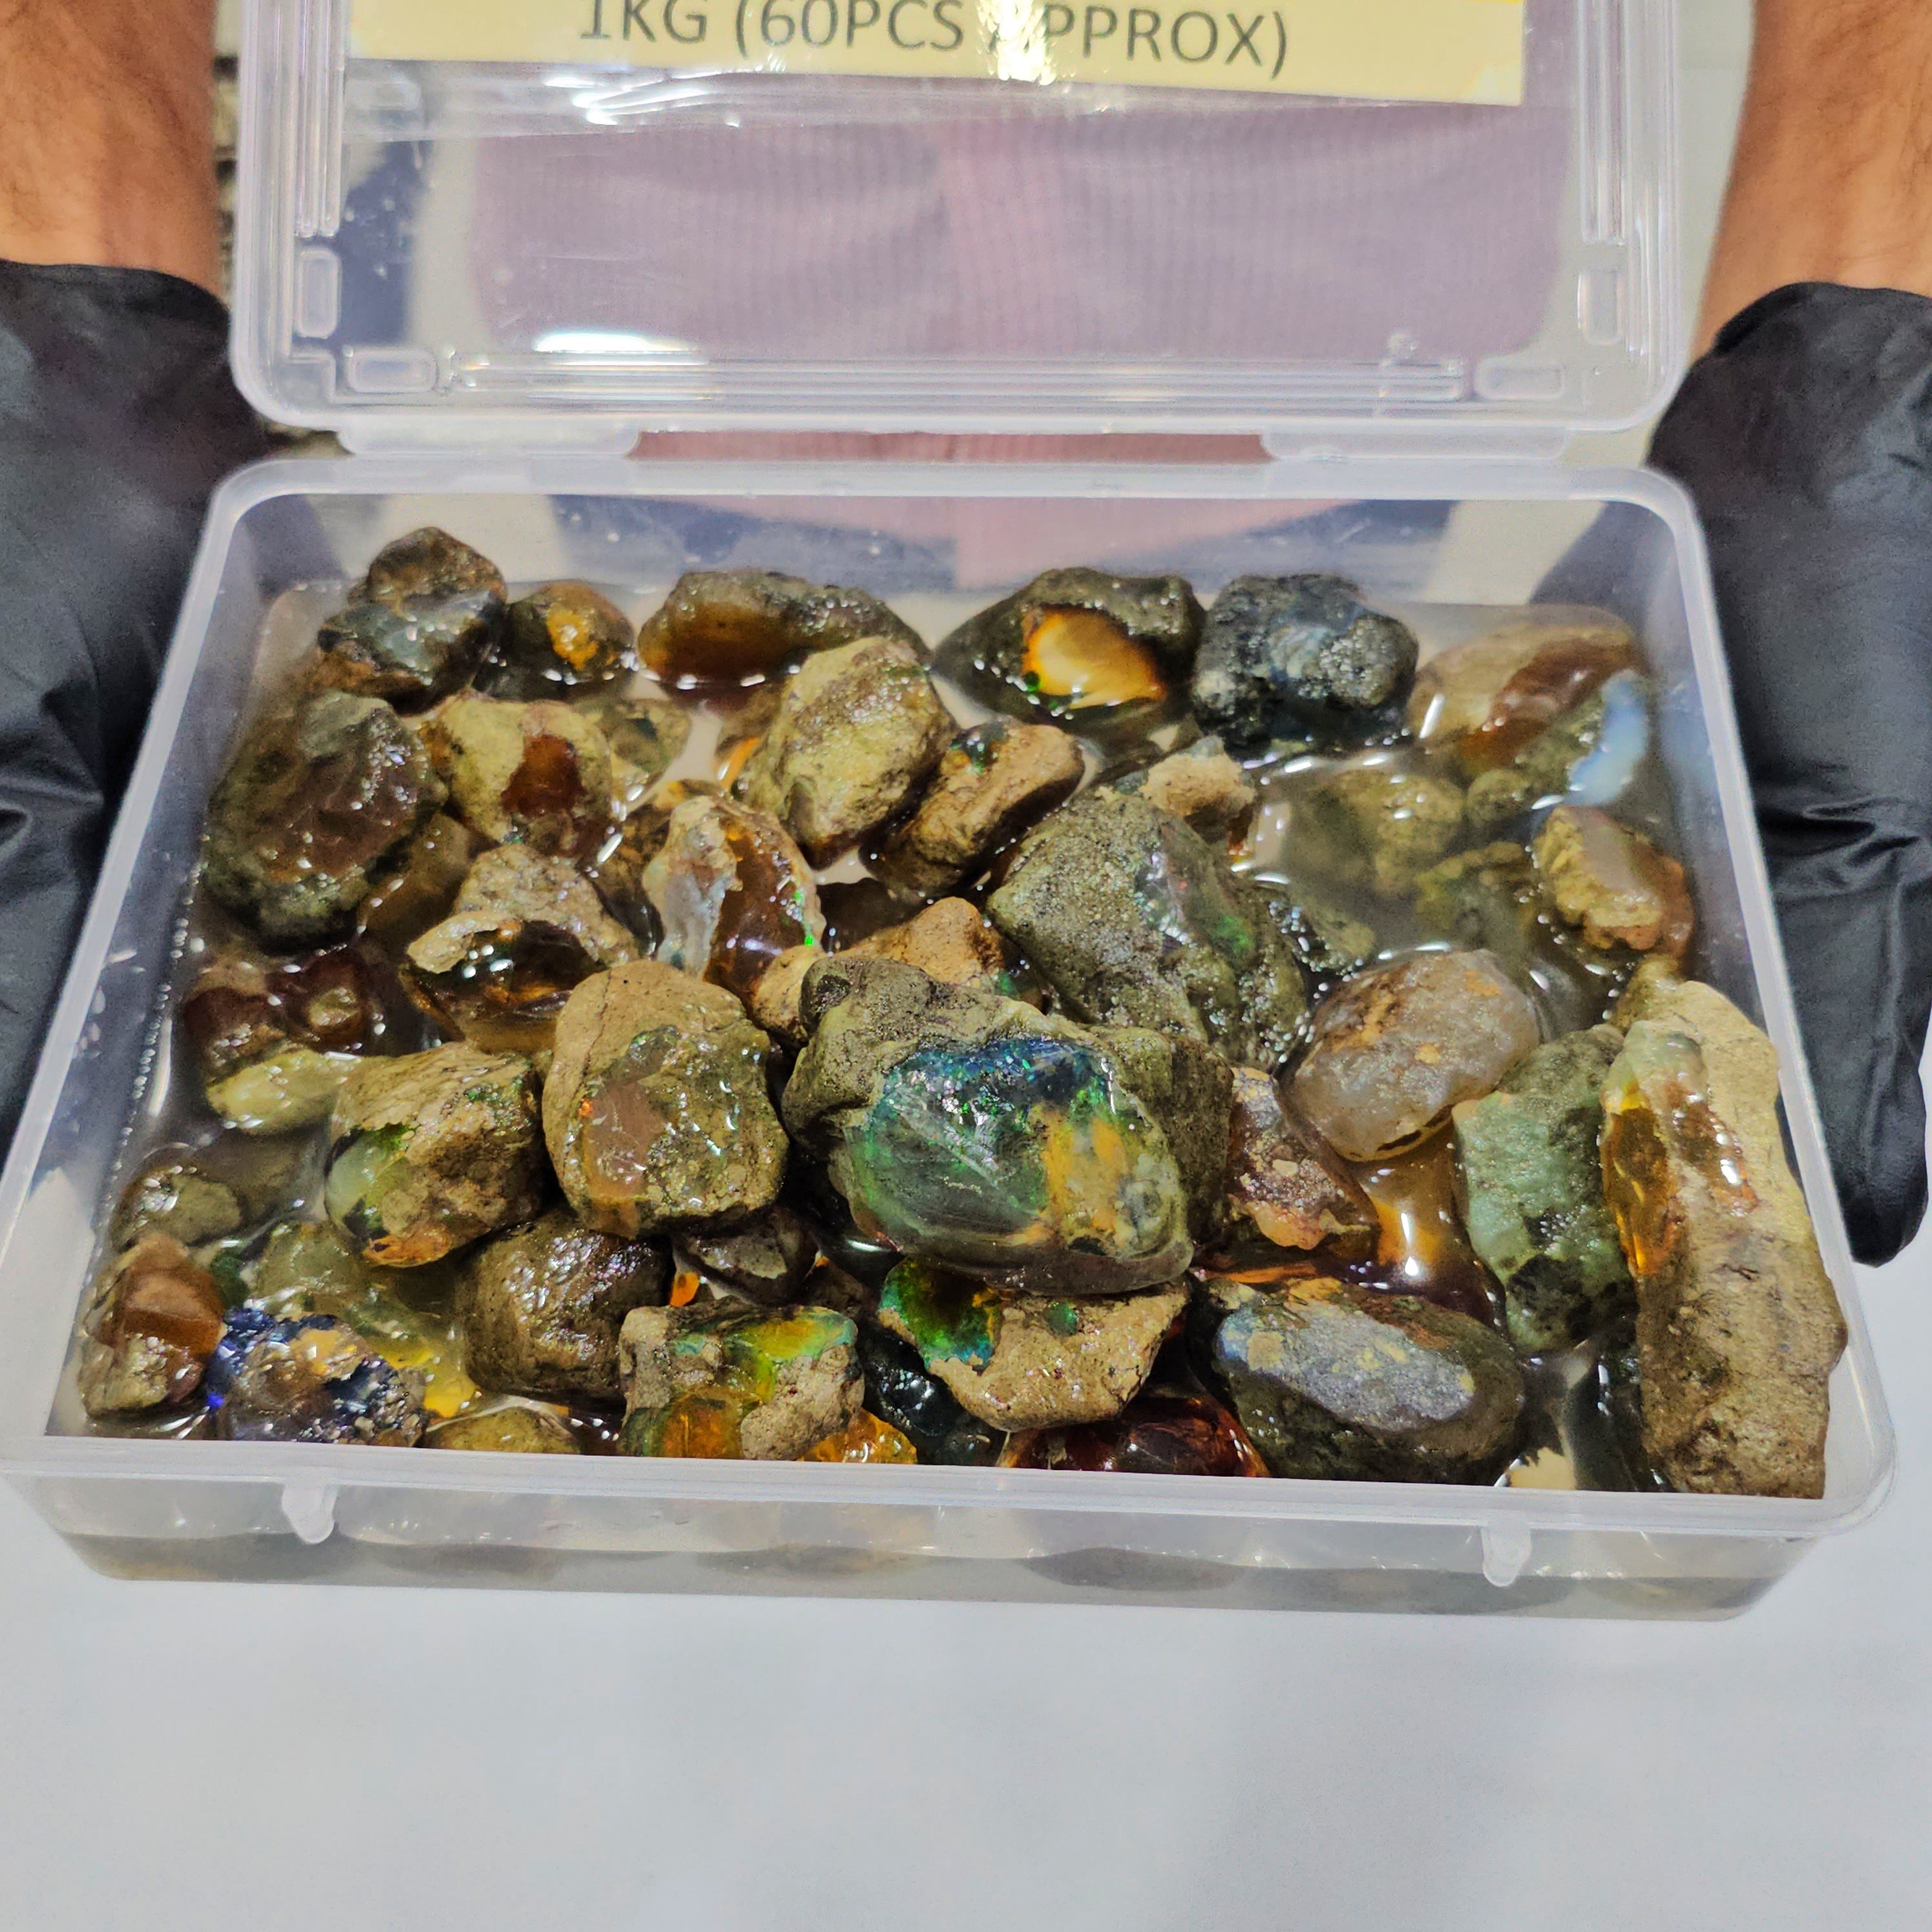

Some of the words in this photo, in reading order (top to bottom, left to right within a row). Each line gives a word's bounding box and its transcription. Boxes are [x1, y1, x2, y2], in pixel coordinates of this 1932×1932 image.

[580, 0, 707, 43] 1KG
[735, 0, 963, 58] (60PCS
[987, 4, 1286, 81] PPROX)
